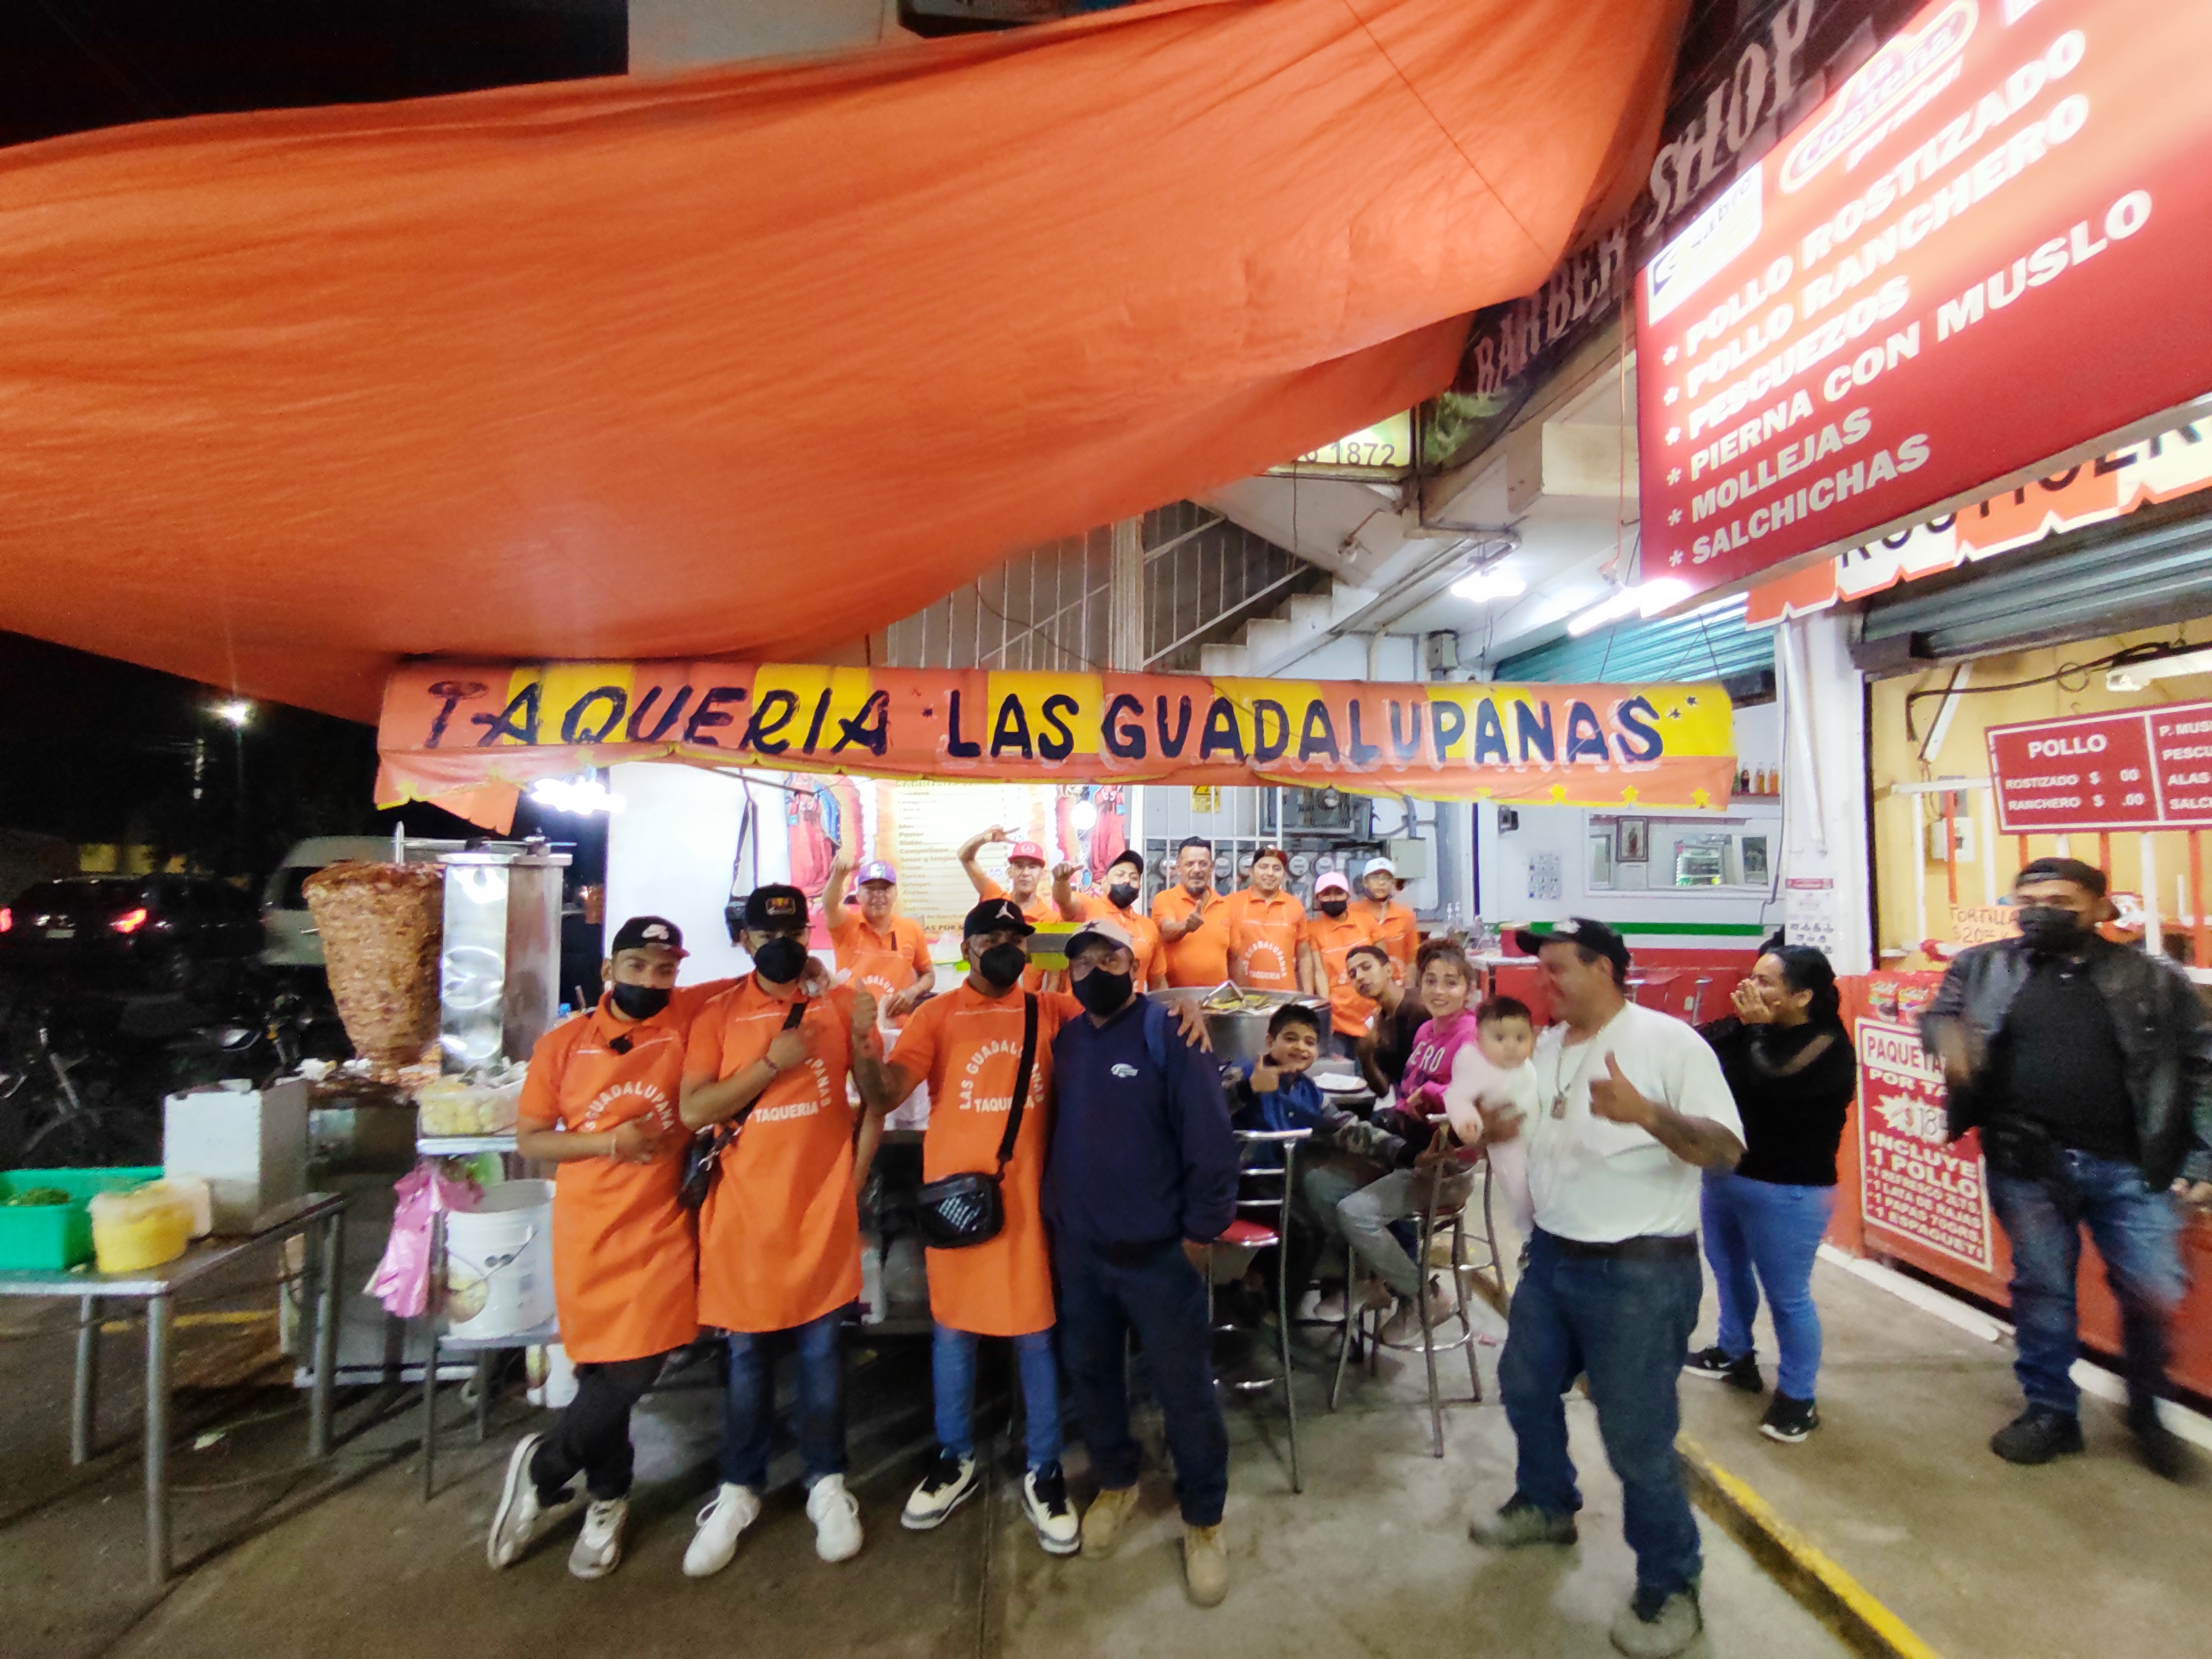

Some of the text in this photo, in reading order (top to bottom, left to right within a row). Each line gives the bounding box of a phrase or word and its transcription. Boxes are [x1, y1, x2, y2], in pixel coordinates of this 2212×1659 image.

[1685, 255, 1794, 357] POLLO
[1801, 29, 2086, 270] ROSTIZADO
[1686, 303, 1795, 399] POLLO
[1801, 94, 2089, 320] RANCHERO
[1688, 275, 1910, 441] PESCUEZOS
[1690, 189, 2153, 482] PIERNA CON MUSLO
[1330, 441, 1395, 467] 1872
[1691, 407, 1872, 525] MOLLEJAS
[1692, 433, 1931, 565] SALCHICHAS
[426, 680, 1665, 766] TAQUERIA LAS GUADALUPANAS
[2028, 734, 2107, 758] POLLO
[2005, 774, 2080, 790] ROSTIZADO
[2089, 771, 2100, 785] $
[2008, 796, 2081, 811] RANCHERO
[2093, 794, 2104, 807] $
[2168, 771, 2211, 785] ALAS
[1407, 1041, 1446, 1073] ERO
[1869, 1067, 1915, 1090] POR
[585, 1080, 675, 1131] GUADALUPANA
[754, 1101, 819, 1123] TAQUERIA
[959, 1080, 974, 1110] LAS
[1869, 1130, 1978, 1179] INCLUYE
[1871, 1149, 1978, 1199] 1 POLLO
